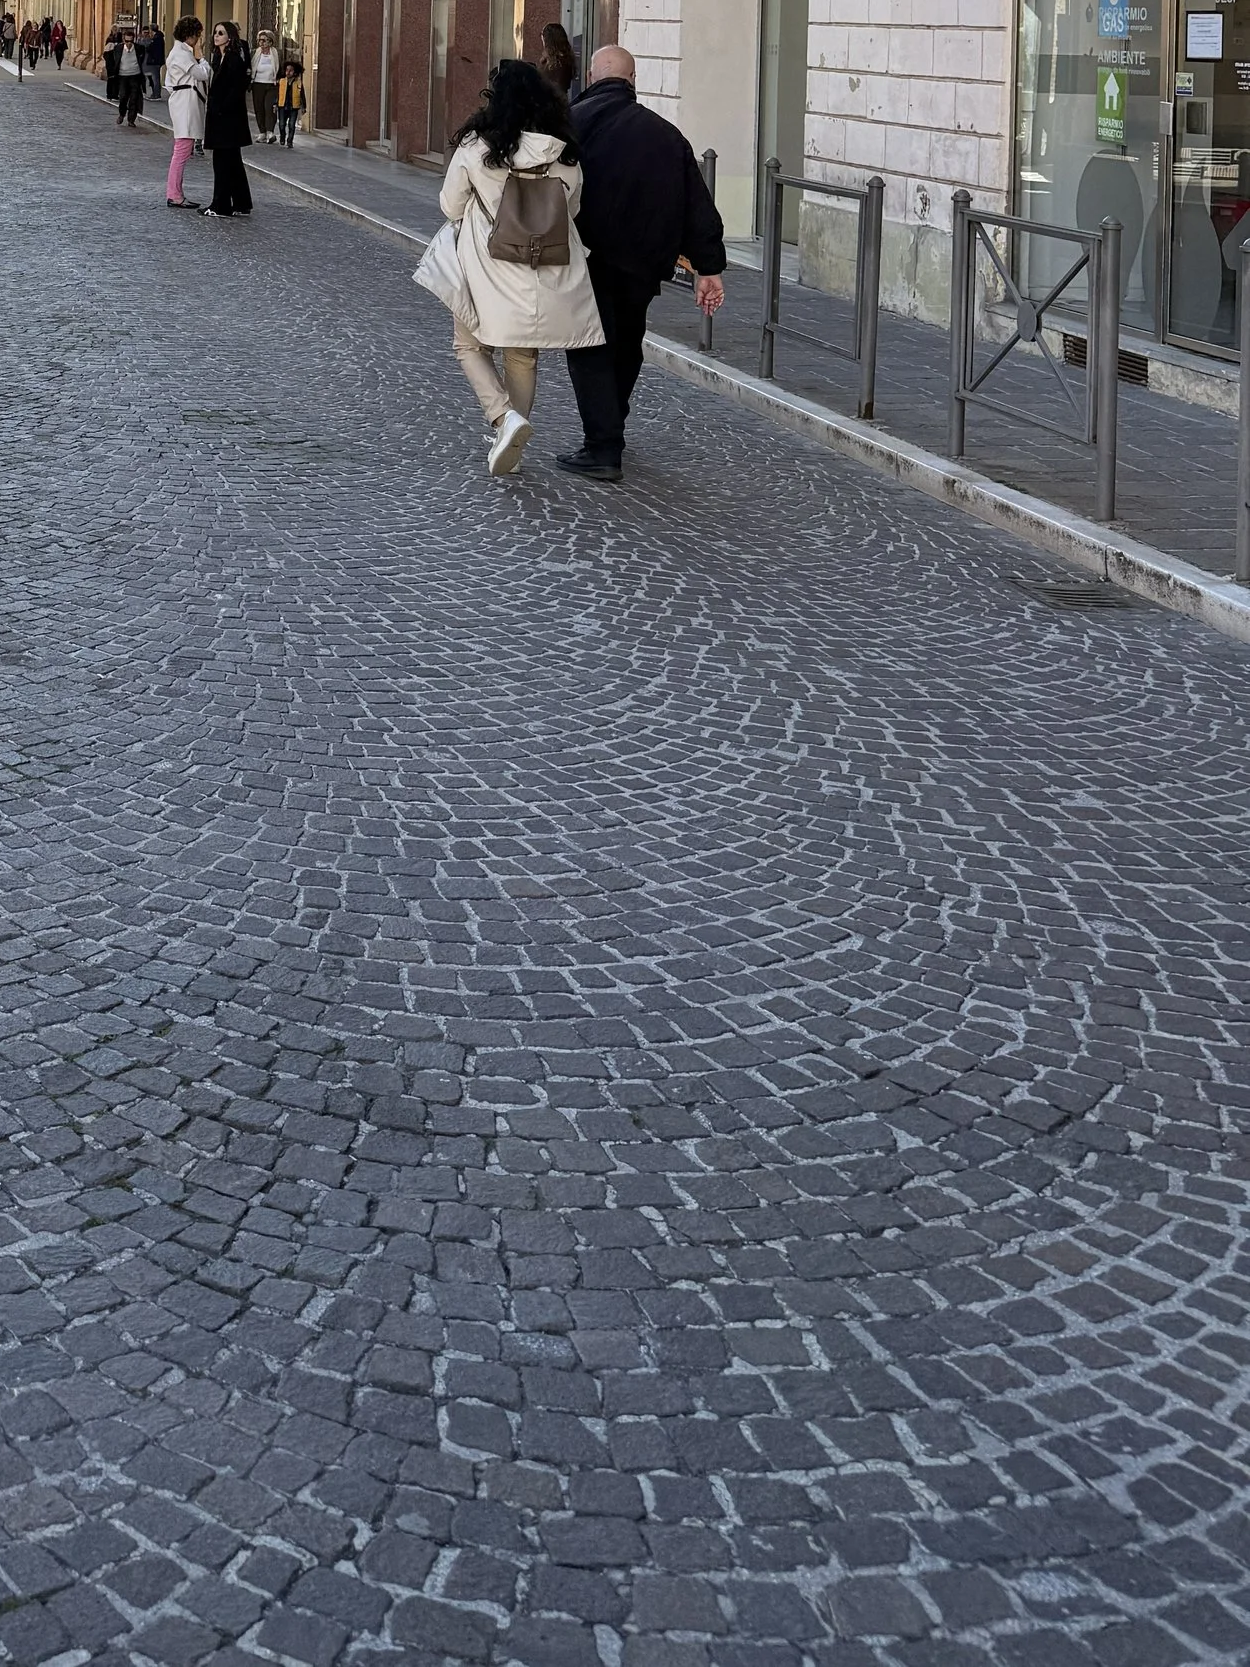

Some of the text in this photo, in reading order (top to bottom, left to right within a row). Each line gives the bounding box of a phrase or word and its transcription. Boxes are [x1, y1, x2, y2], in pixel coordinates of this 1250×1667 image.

[1099, 6, 1148, 21] RISPARMIO
[1103, 12, 1125, 32] GAS
[1097, 50, 1146, 65] AMBIENTE
[1098, 116, 1124, 130] RISPARMIO
[1097, 126, 1124, 140] ENERGETICO
